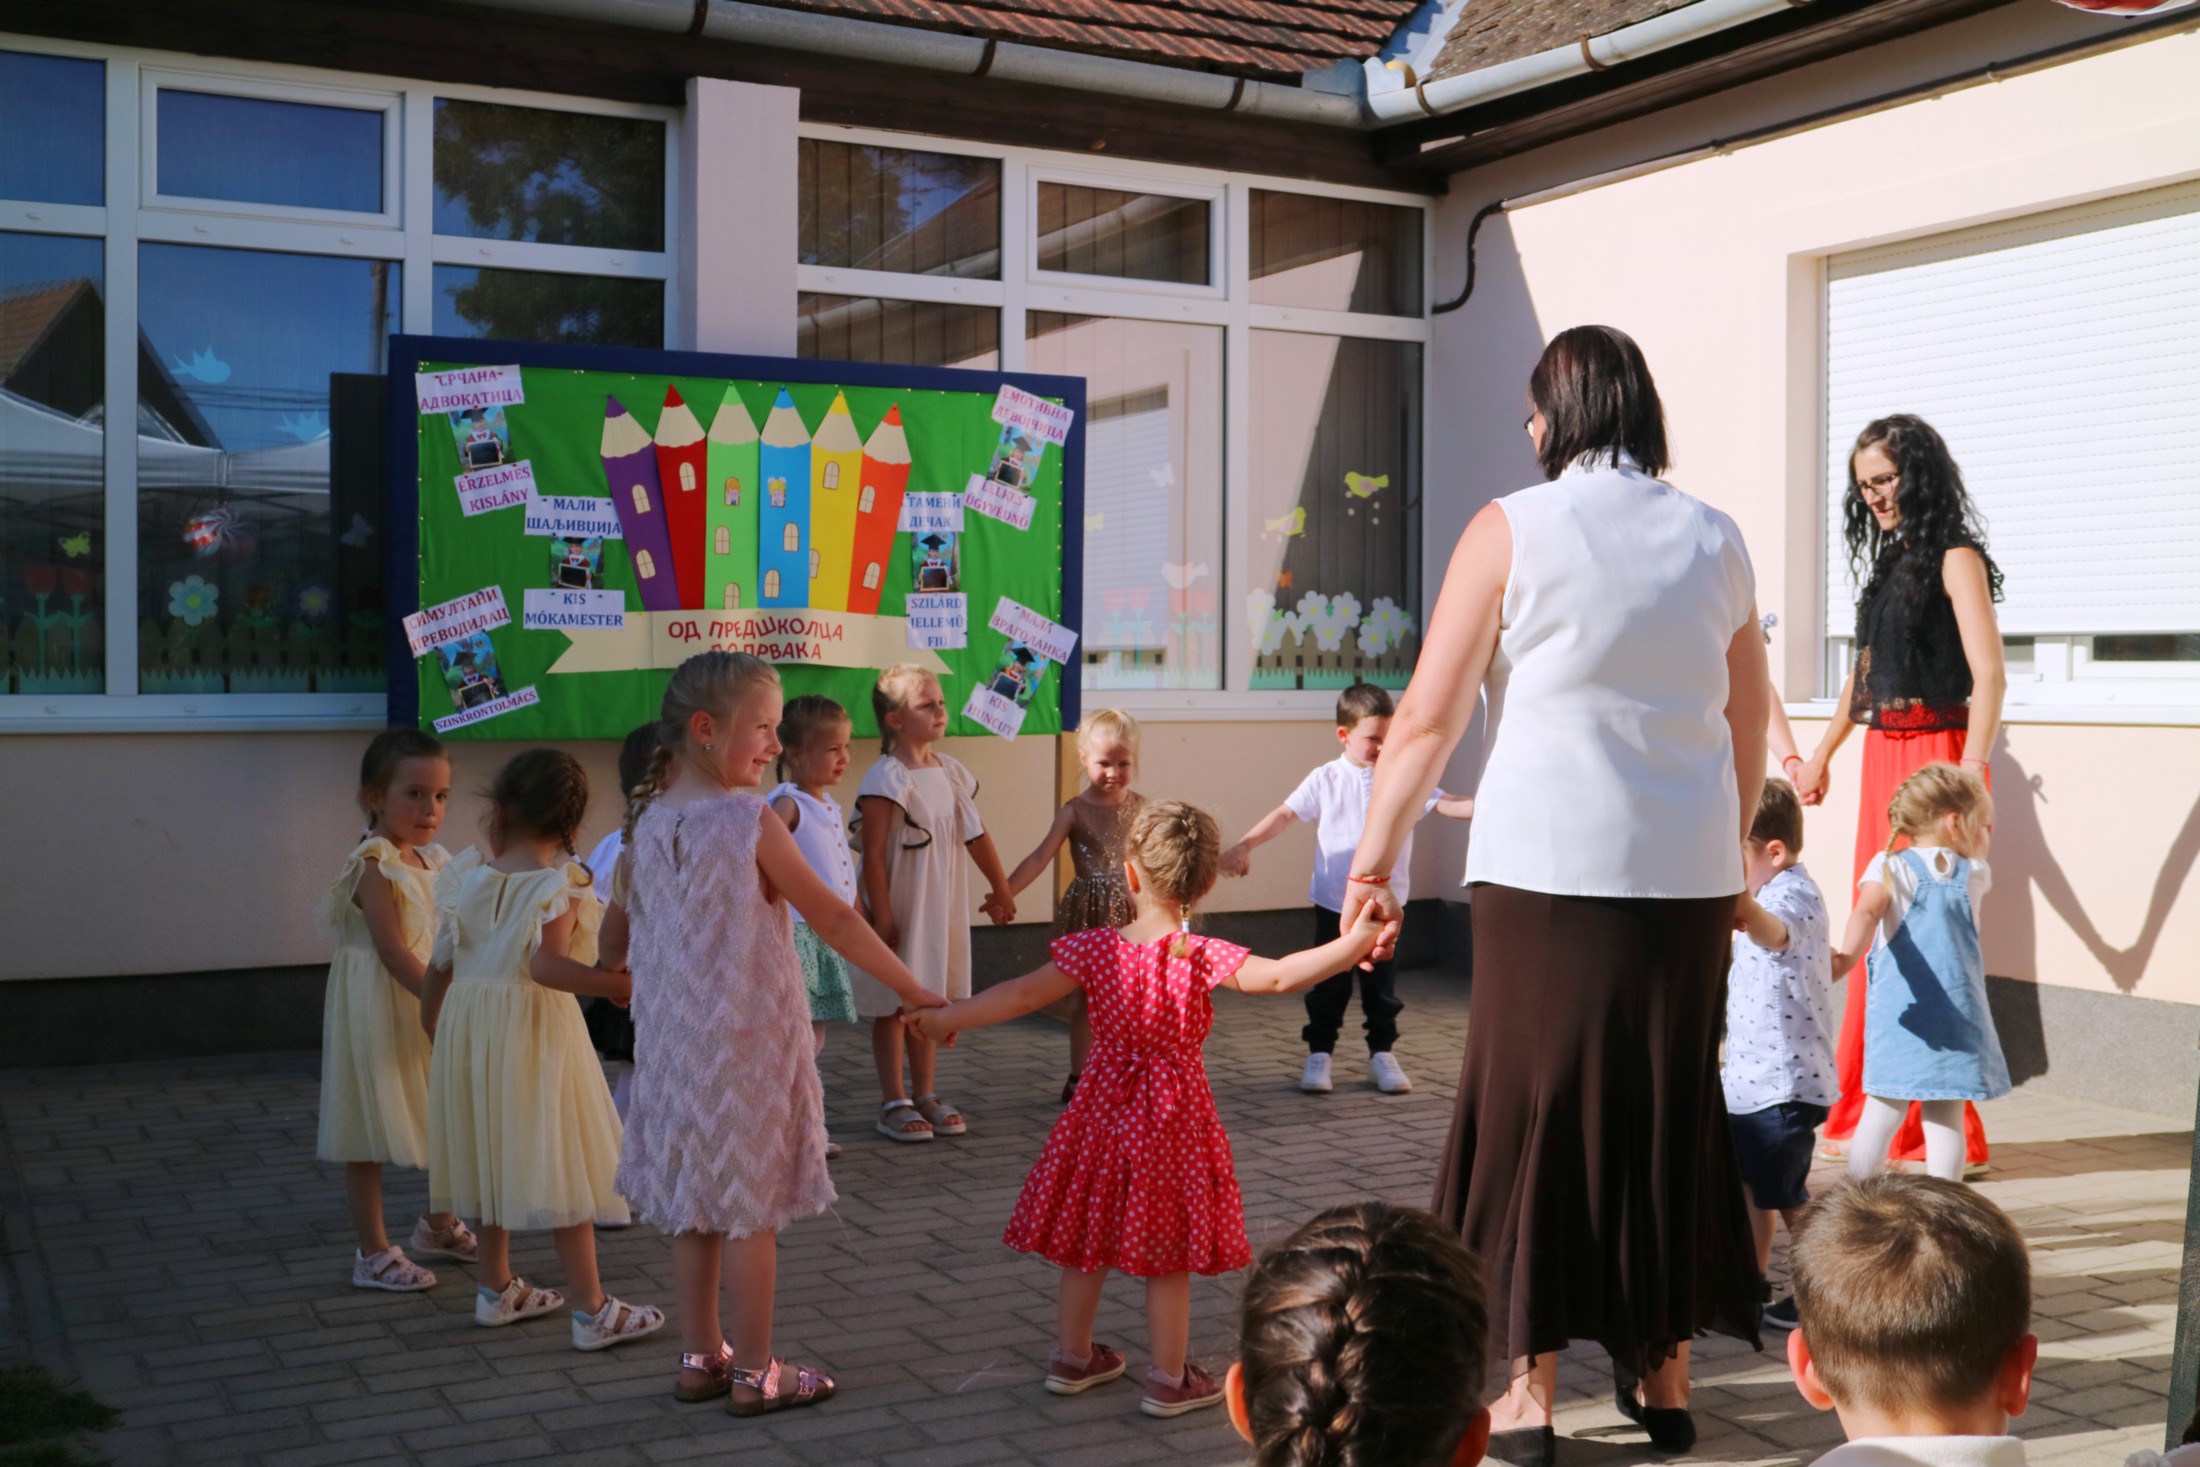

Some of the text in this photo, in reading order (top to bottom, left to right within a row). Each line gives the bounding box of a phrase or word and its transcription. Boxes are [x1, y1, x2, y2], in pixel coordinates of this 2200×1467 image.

[439, 370, 497, 387] СРЧАНА
[421, 389, 522, 411] АДВОКАТИЦА
[1003, 388, 1068, 422] ЕМОТИВНА
[994, 406, 1063, 440] ДЕВОЈЧИЦА
[470, 488, 528, 512] KISLÁNY
[553, 498, 596, 511] МАЛИ
[909, 516, 951, 527] ДЕЧАК
[409, 589, 498, 629] СИМУЛТАНИ
[563, 593, 586, 605] KIS
[912, 596, 962, 609] SZILÁRD
[412, 607, 510, 651] ПРЕВОДИЛАЦ
[525, 610, 623, 626] MÓKAMESTER
[668, 616, 842, 643] ОД ПРЕДШКОЛЦА
[1019, 610, 1052, 634] МАЛА
[992, 616, 1068, 662] ВРАГОЛАНКА
[436, 690, 536, 729] SZINKRONTOLMÁCS
[989, 695, 1008, 712] KIS
[967, 703, 1015, 736] HUNCUT
